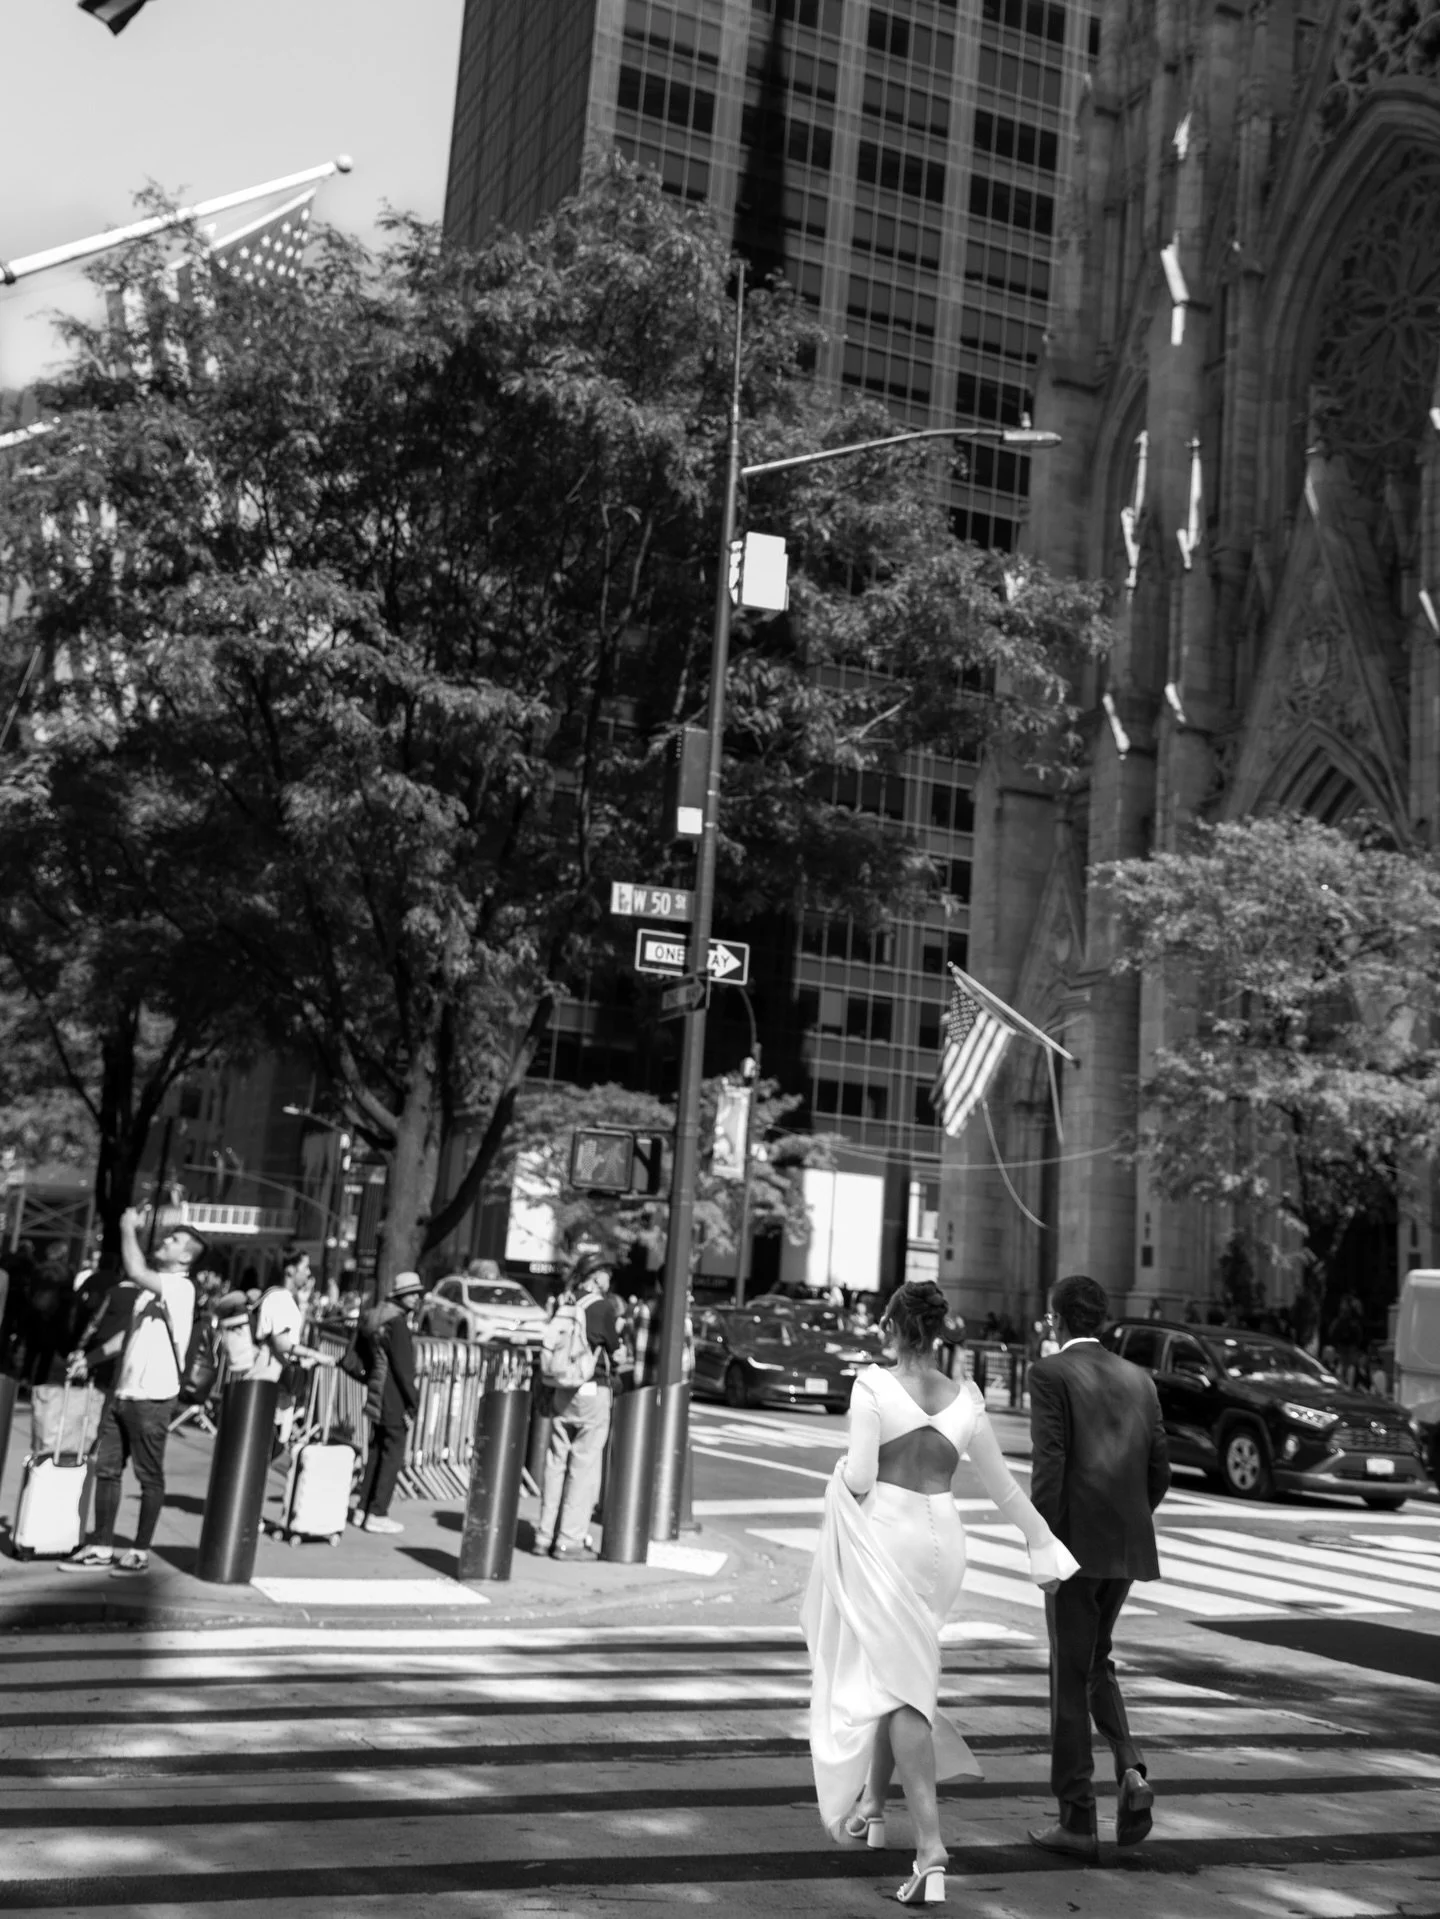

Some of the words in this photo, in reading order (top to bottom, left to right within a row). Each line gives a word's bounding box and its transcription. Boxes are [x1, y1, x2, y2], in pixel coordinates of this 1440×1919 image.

[634, 889, 647, 913] W
[651, 891, 671, 916] 50
[655, 944, 684, 963] ONE
[711, 953, 729, 969] AY
